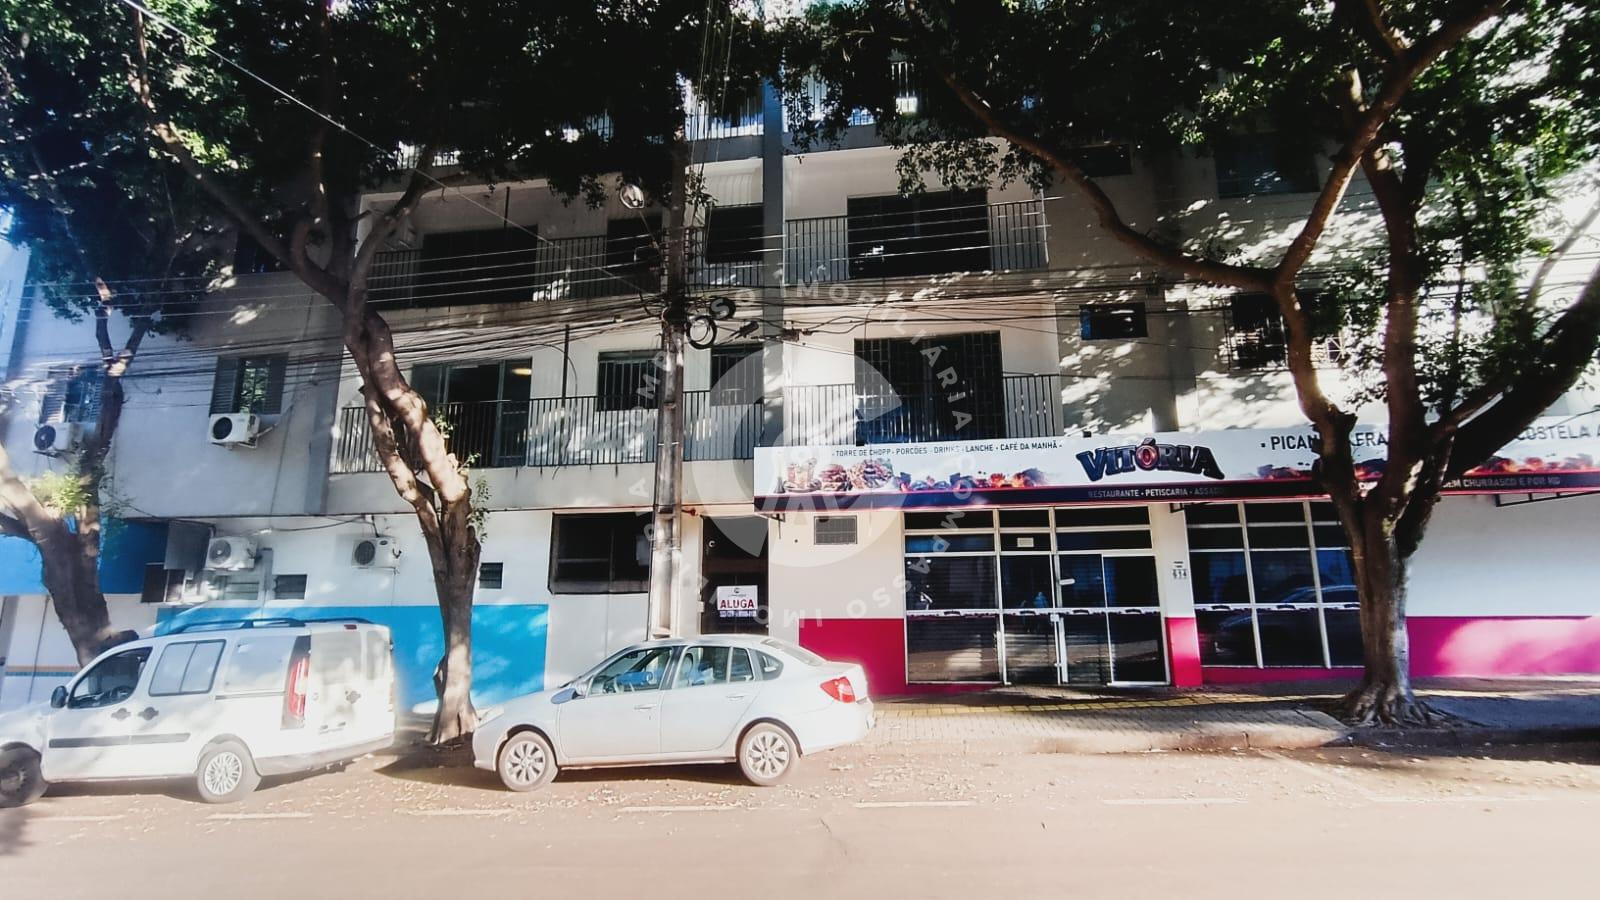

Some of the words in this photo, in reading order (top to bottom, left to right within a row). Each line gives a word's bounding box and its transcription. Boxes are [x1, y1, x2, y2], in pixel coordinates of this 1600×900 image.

[1514, 425, 1591, 441] OSTELA
[836, 449, 857, 457] TORRE
[869, 448, 891, 456] CHOPP
[966, 444, 993, 453] LANCHE
[1000, 442, 1018, 451] CAFÉ
[1020, 442, 1029, 450] DA
[1032, 440, 1057, 450] MANHÃ
[1076, 437, 1225, 482] VITÓRIA
[1088, 489, 1139, 498] RESTAURANTE
[1145, 488, 1188, 497] PETISCARIA
[720, 599, 754, 608] ALUGA
